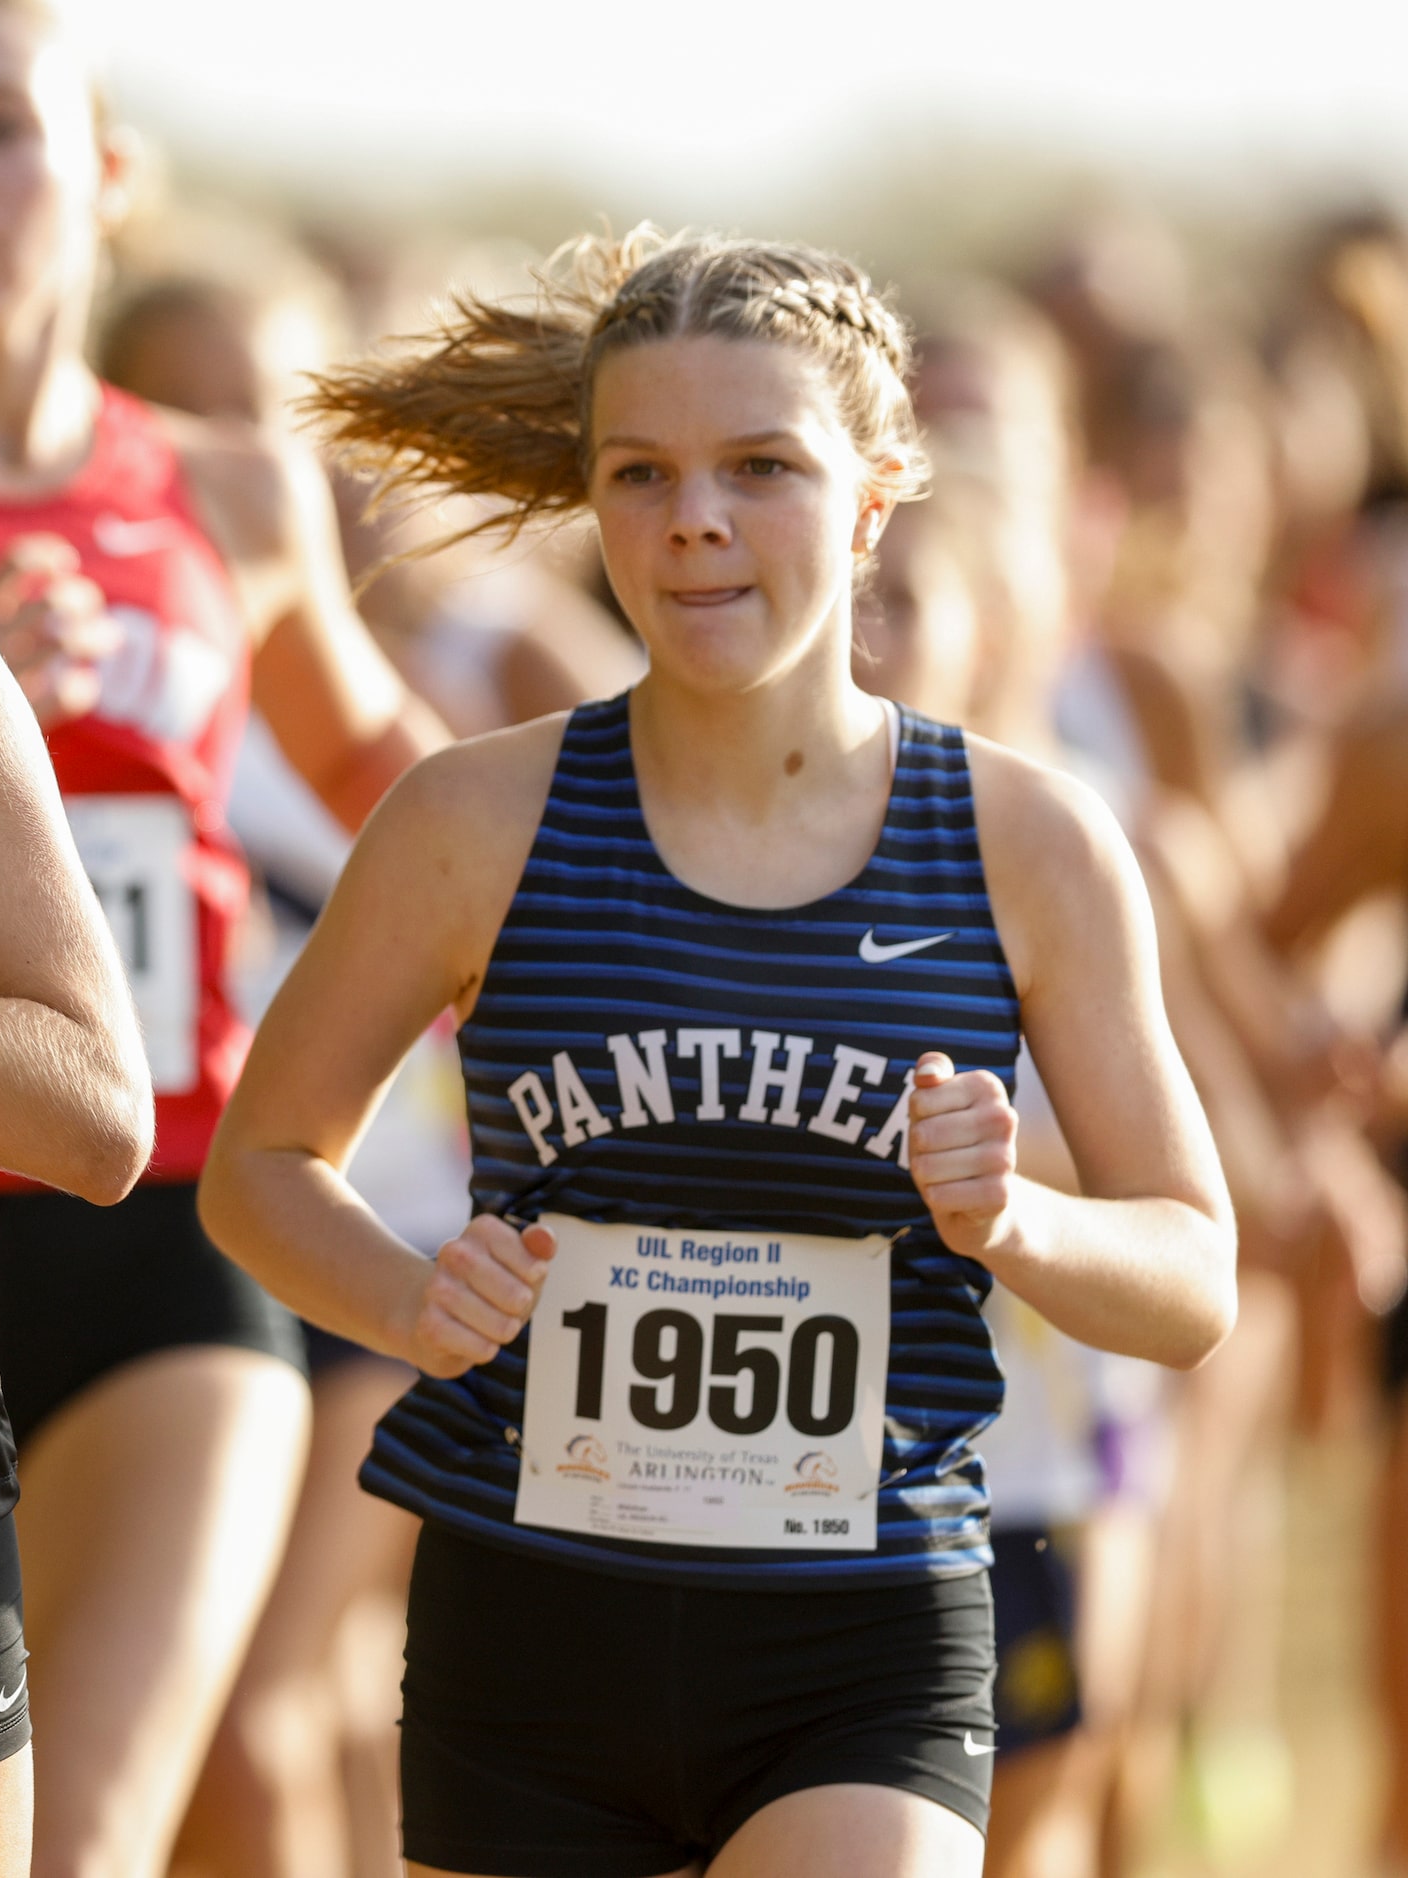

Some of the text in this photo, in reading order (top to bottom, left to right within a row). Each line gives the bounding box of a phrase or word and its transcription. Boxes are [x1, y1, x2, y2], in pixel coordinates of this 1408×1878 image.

[637, 1236, 781, 1266] UIL Region II
[610, 1266, 811, 1302] XC Championship
[562, 1301, 859, 1437] 1950
[616, 1441, 779, 1464] The University of Texas
[629, 1459, 764, 1486] ARLINGTON
